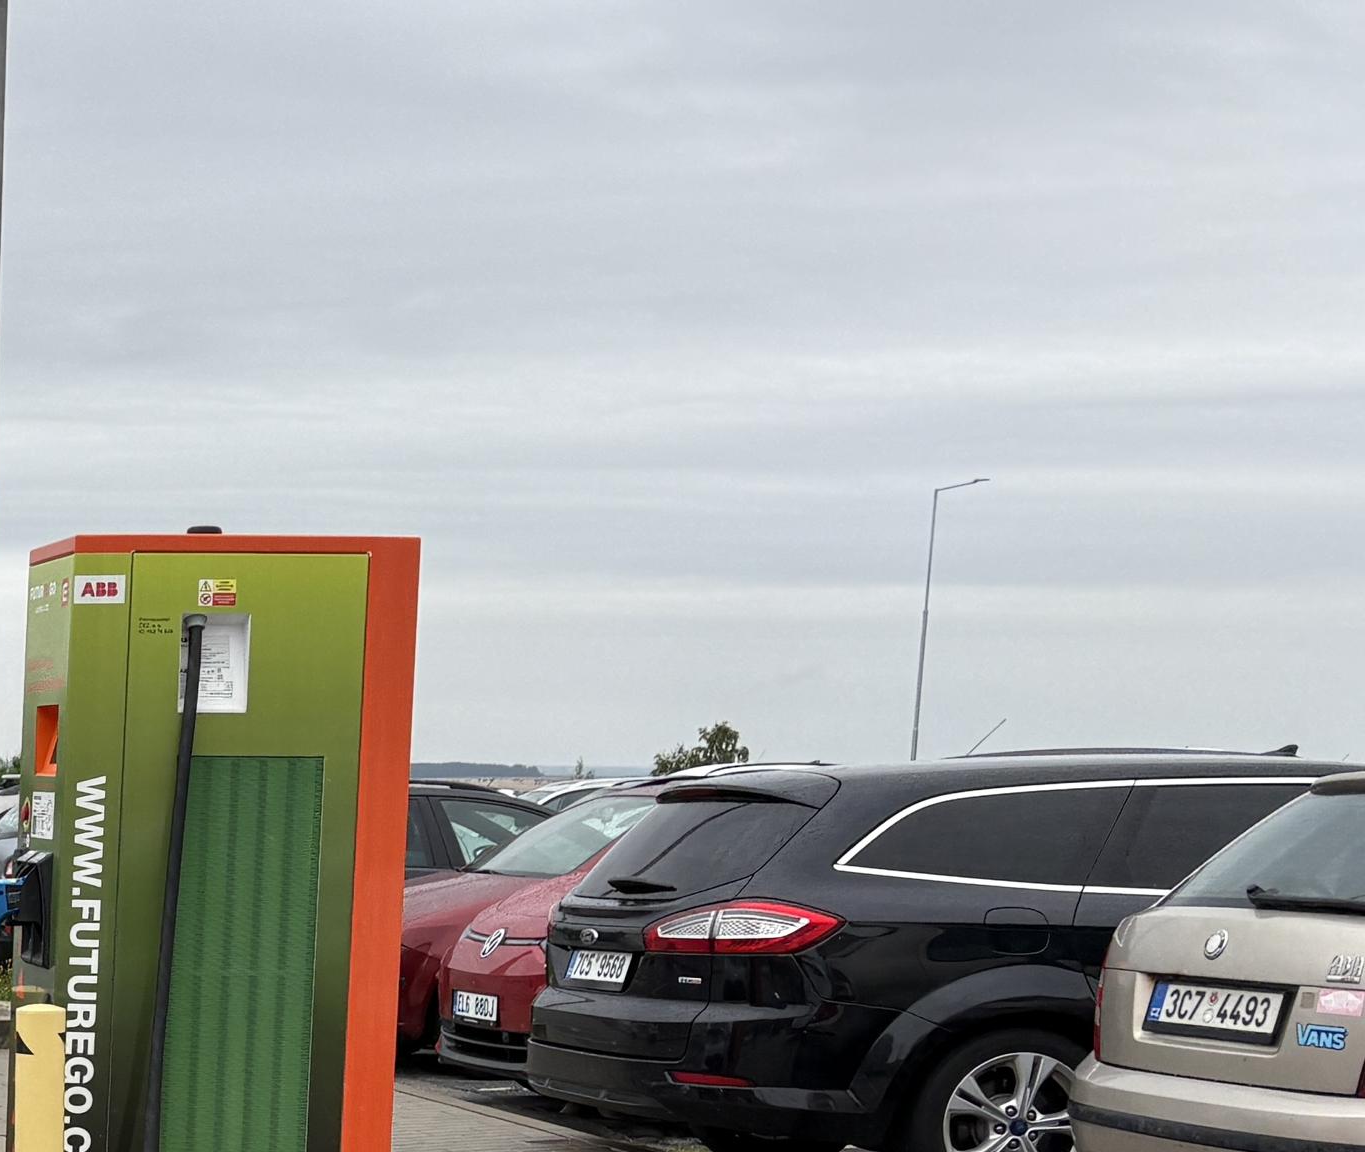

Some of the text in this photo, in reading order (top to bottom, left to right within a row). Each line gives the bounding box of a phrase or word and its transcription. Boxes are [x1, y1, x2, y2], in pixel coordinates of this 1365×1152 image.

[80, 581, 119, 598] ABB
[1165, 988, 1272, 1028] 3C7 4493
[1296, 1022, 1349, 1051] VANS
